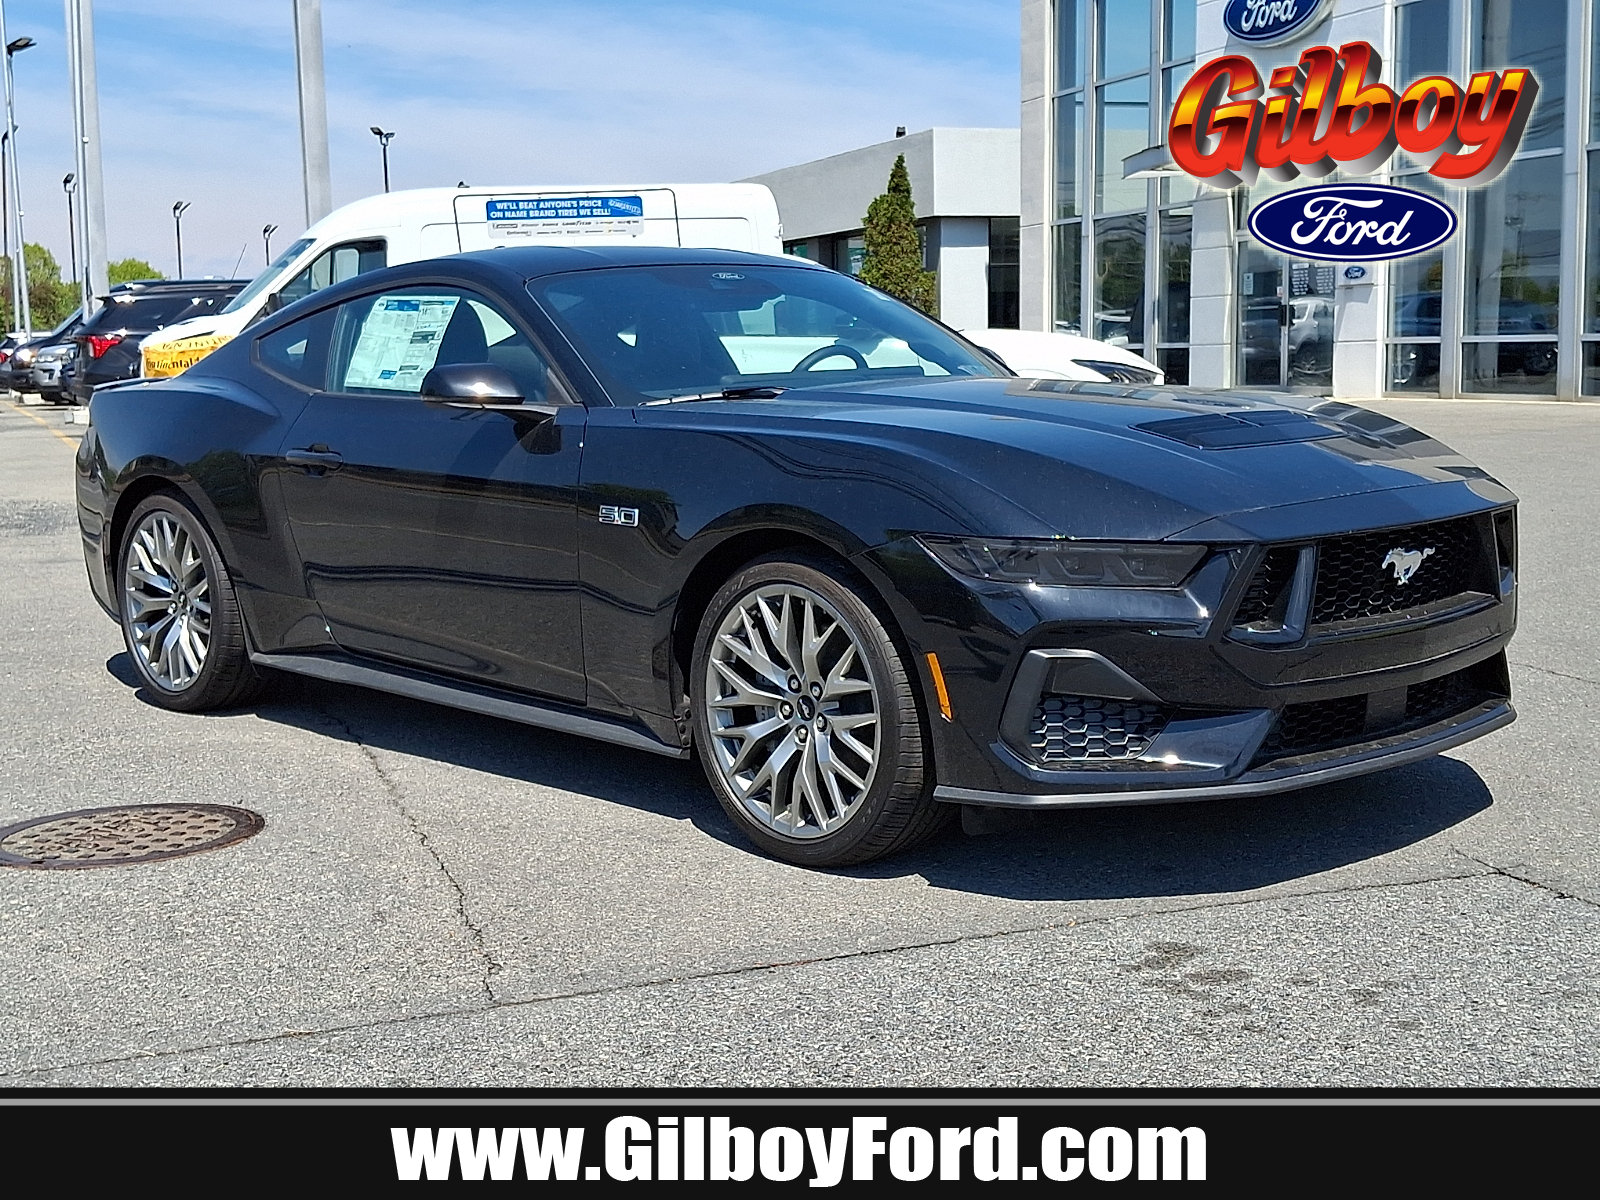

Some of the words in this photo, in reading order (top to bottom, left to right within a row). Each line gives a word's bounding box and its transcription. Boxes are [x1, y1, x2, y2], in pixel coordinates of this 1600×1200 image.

[1241, 0, 1298, 32] Ford
[495, 202, 517, 210] WE'LL
[518, 201, 537, 210] BEAT
[539, 200, 578, 209] ANYONE'S
[578, 200, 602, 208] PRICE
[504, 210, 528, 218] NAME
[557, 209, 578, 217] TIRES
[579, 208, 592, 216] WE
[592, 208, 611, 216] SELL!
[598, 504, 640, 527] 5.0
